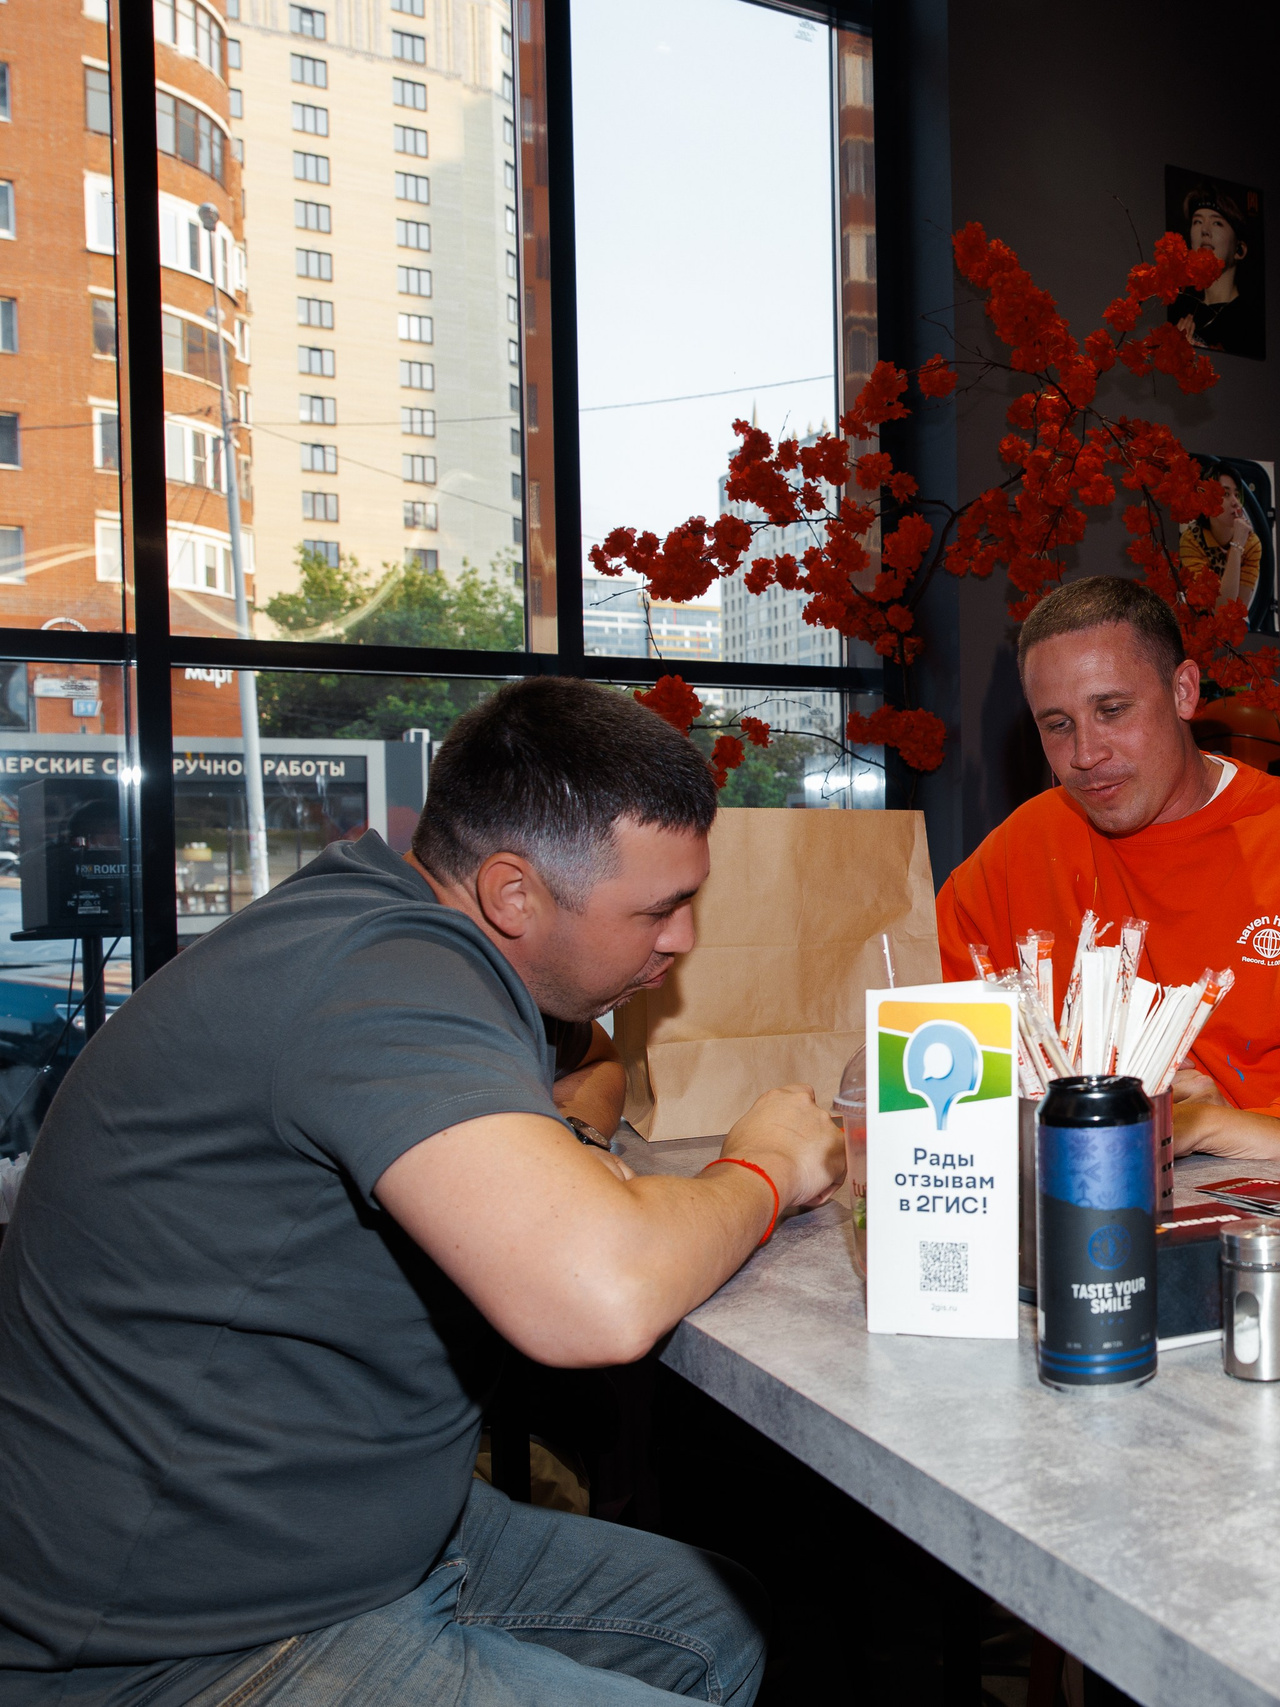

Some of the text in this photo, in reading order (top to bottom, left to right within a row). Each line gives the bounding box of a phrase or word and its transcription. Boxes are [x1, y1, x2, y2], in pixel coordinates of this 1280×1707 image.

[172, 758, 247, 776] РУЧНО
[263, 759, 346, 777] РАБОТЫ
[94, 864, 127, 874] ROKIT
[1236, 915, 1270, 945] haven
[913, 1148, 974, 1170] Рады
[894, 1173, 995, 1189] отзывам
[899, 1195, 988, 1215] в 2ГИС!
[1071, 1276, 1146, 1299] TASTE YOUR
[1090, 1295, 1132, 1314] SMILE
